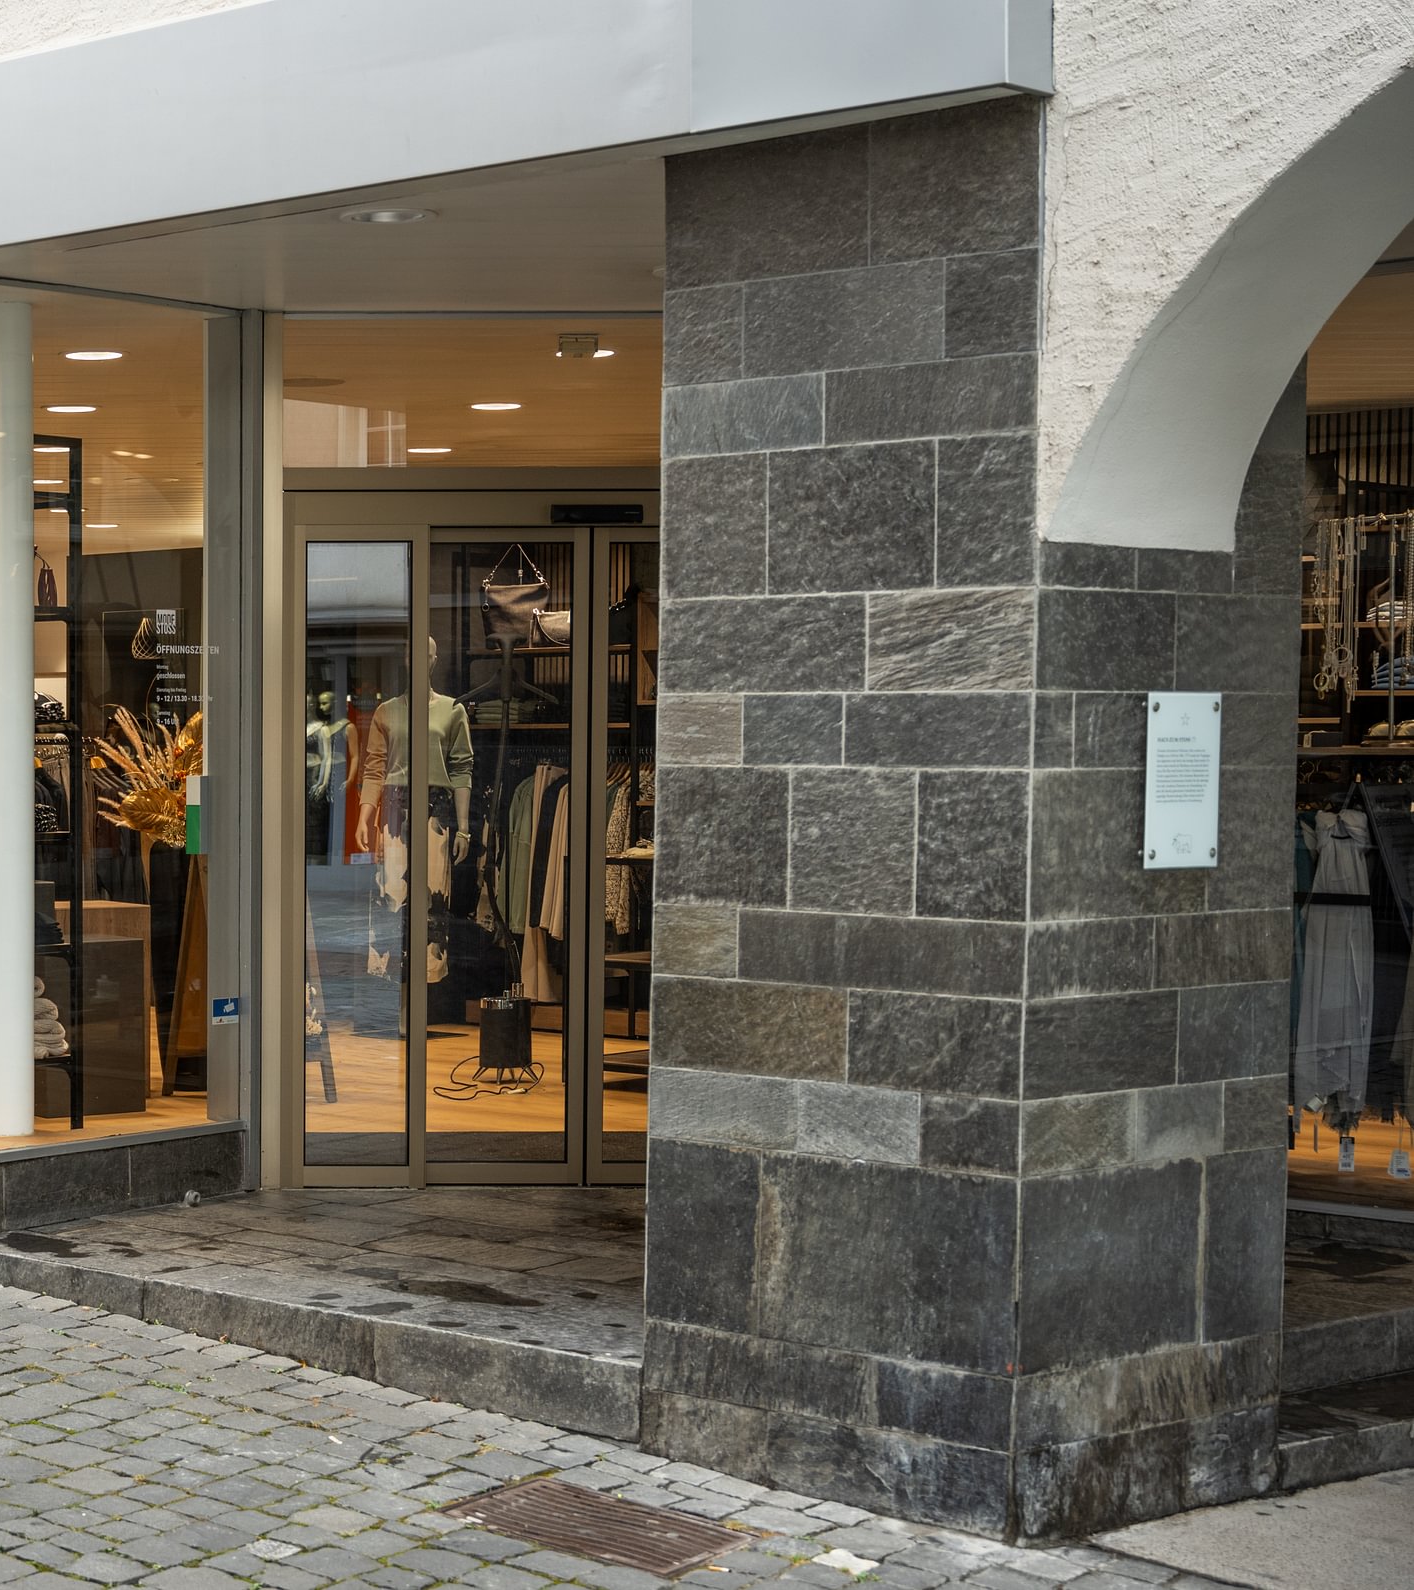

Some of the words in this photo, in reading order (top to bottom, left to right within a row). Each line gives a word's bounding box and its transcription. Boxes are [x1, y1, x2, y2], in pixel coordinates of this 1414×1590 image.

[156, 623, 176, 634] STOSS
[156, 643, 219, 654] ÖFFNUNGSZETEN
[156, 671, 186, 680] geschlossen
